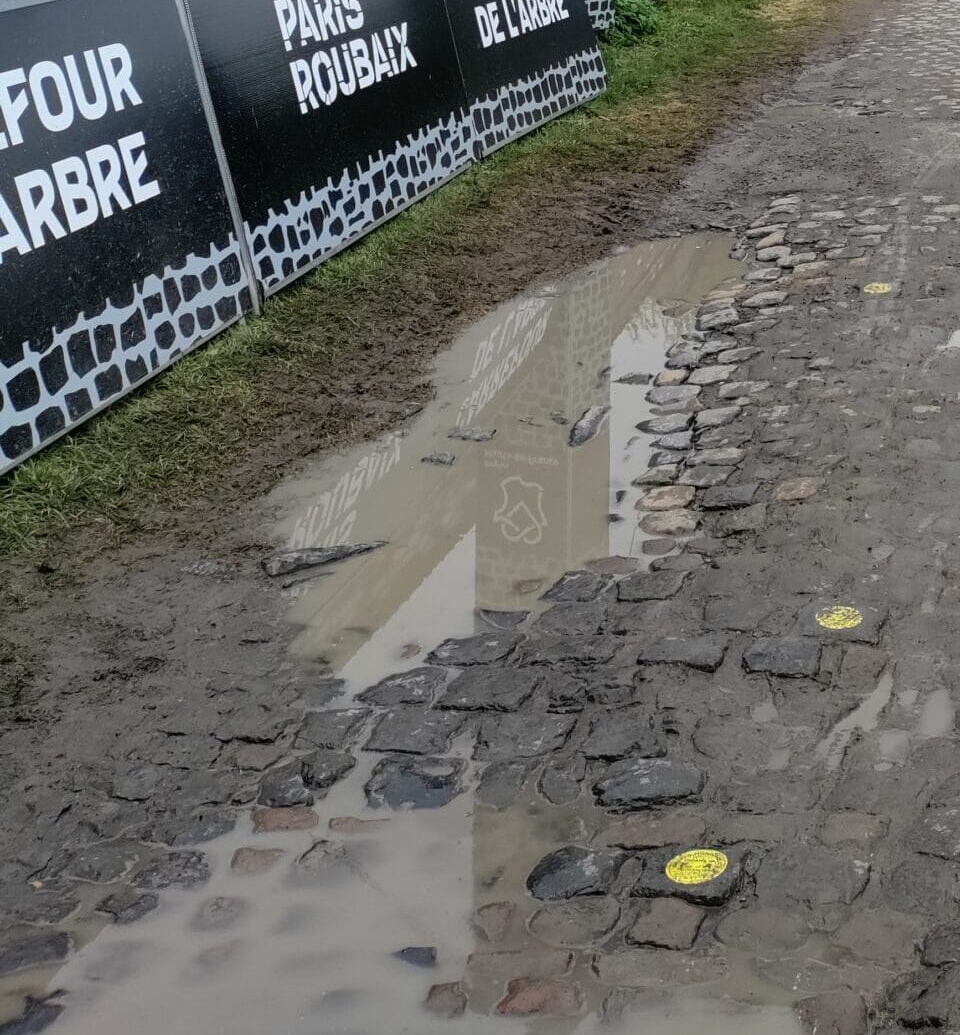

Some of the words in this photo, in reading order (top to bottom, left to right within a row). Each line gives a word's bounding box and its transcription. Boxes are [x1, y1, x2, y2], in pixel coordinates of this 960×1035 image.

[289, 22, 418, 115] ROUBAIX
[473, 1, 506, 49] DE
[0, 42, 143, 151] FOUR
